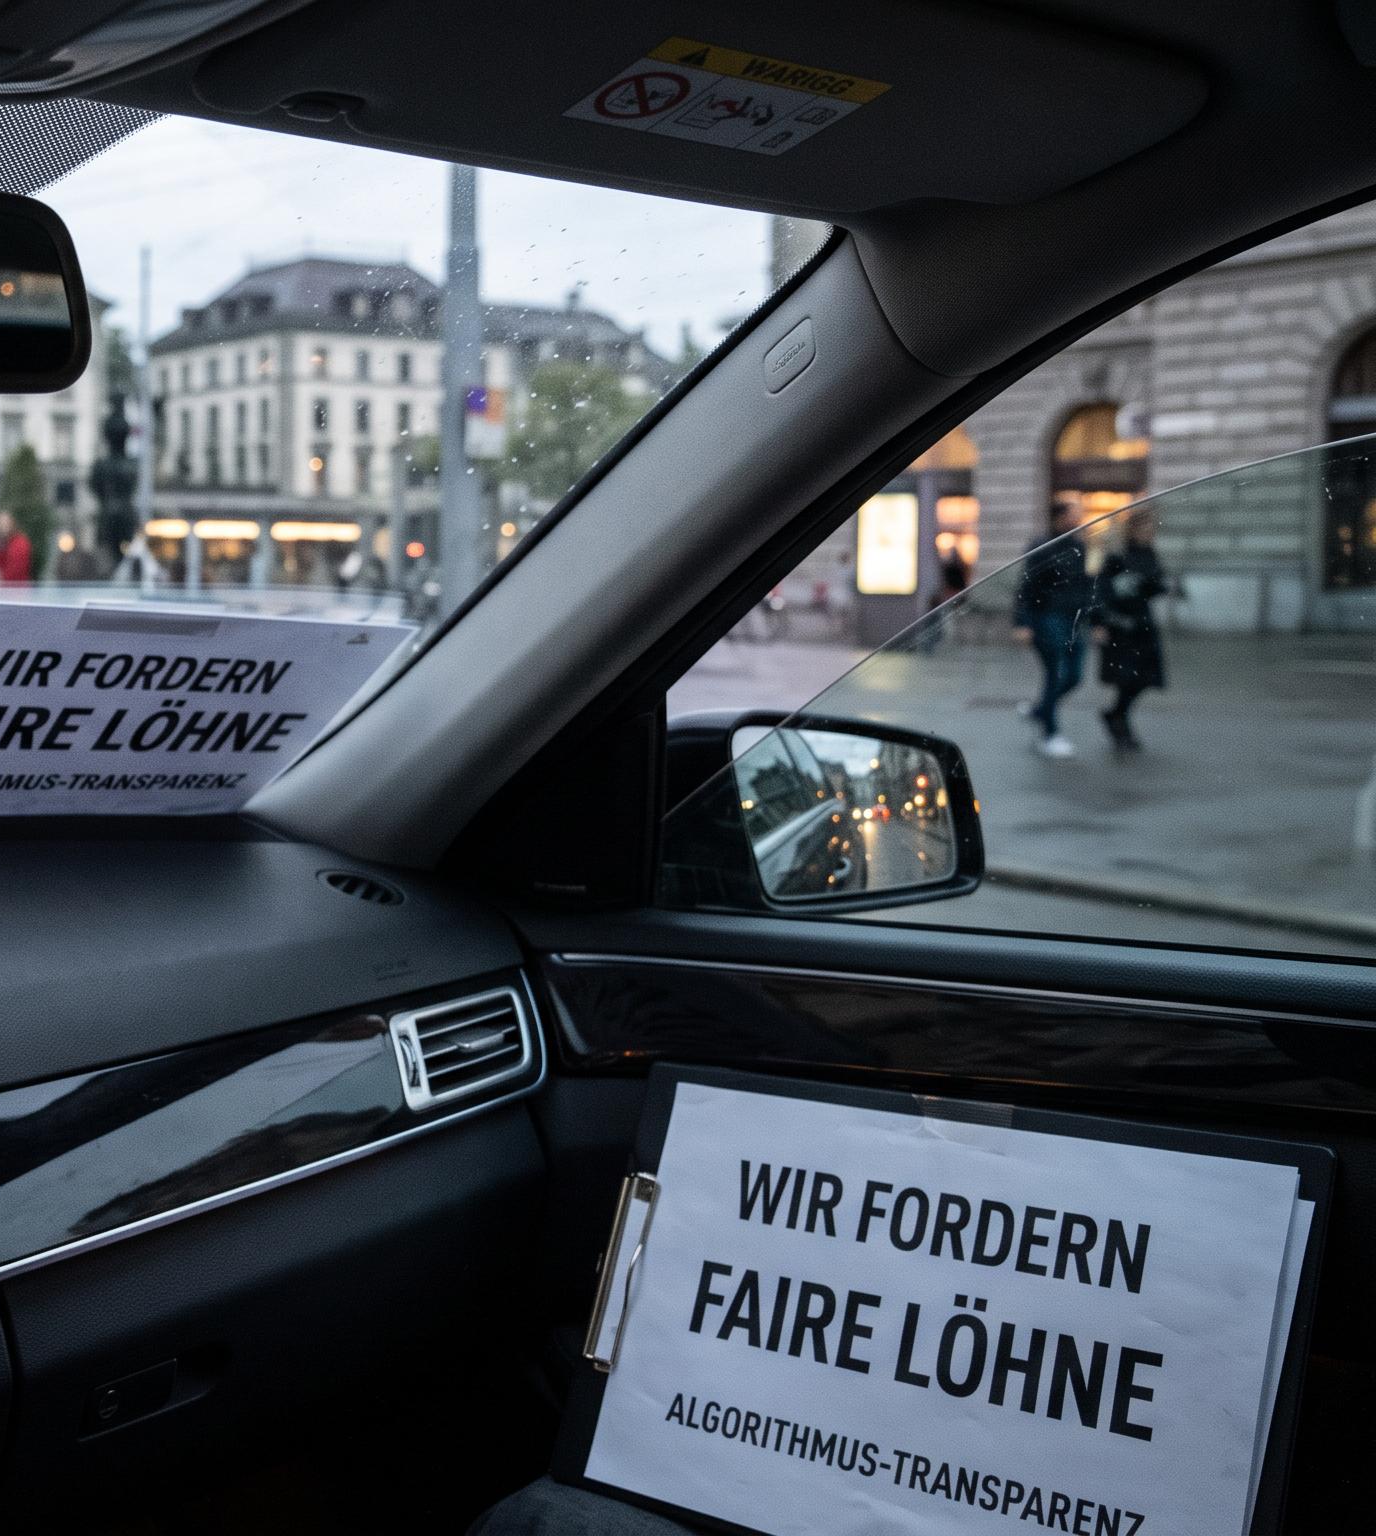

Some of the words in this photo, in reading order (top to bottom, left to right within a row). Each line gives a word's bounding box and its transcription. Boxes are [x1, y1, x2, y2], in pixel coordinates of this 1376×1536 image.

[66, 653, 293, 694] FORDERN
[90, 700, 307, 753] LÖHNE
[737, 1160, 844, 1237] WIR
[856, 1180, 1152, 1294] FORDERN
[688, 1260, 882, 1375] FAIRE
[893, 1295, 1165, 1442] LÖHNE
[665, 1392, 1146, 1536] ALGORITHMUS-TRANSPARENZ
